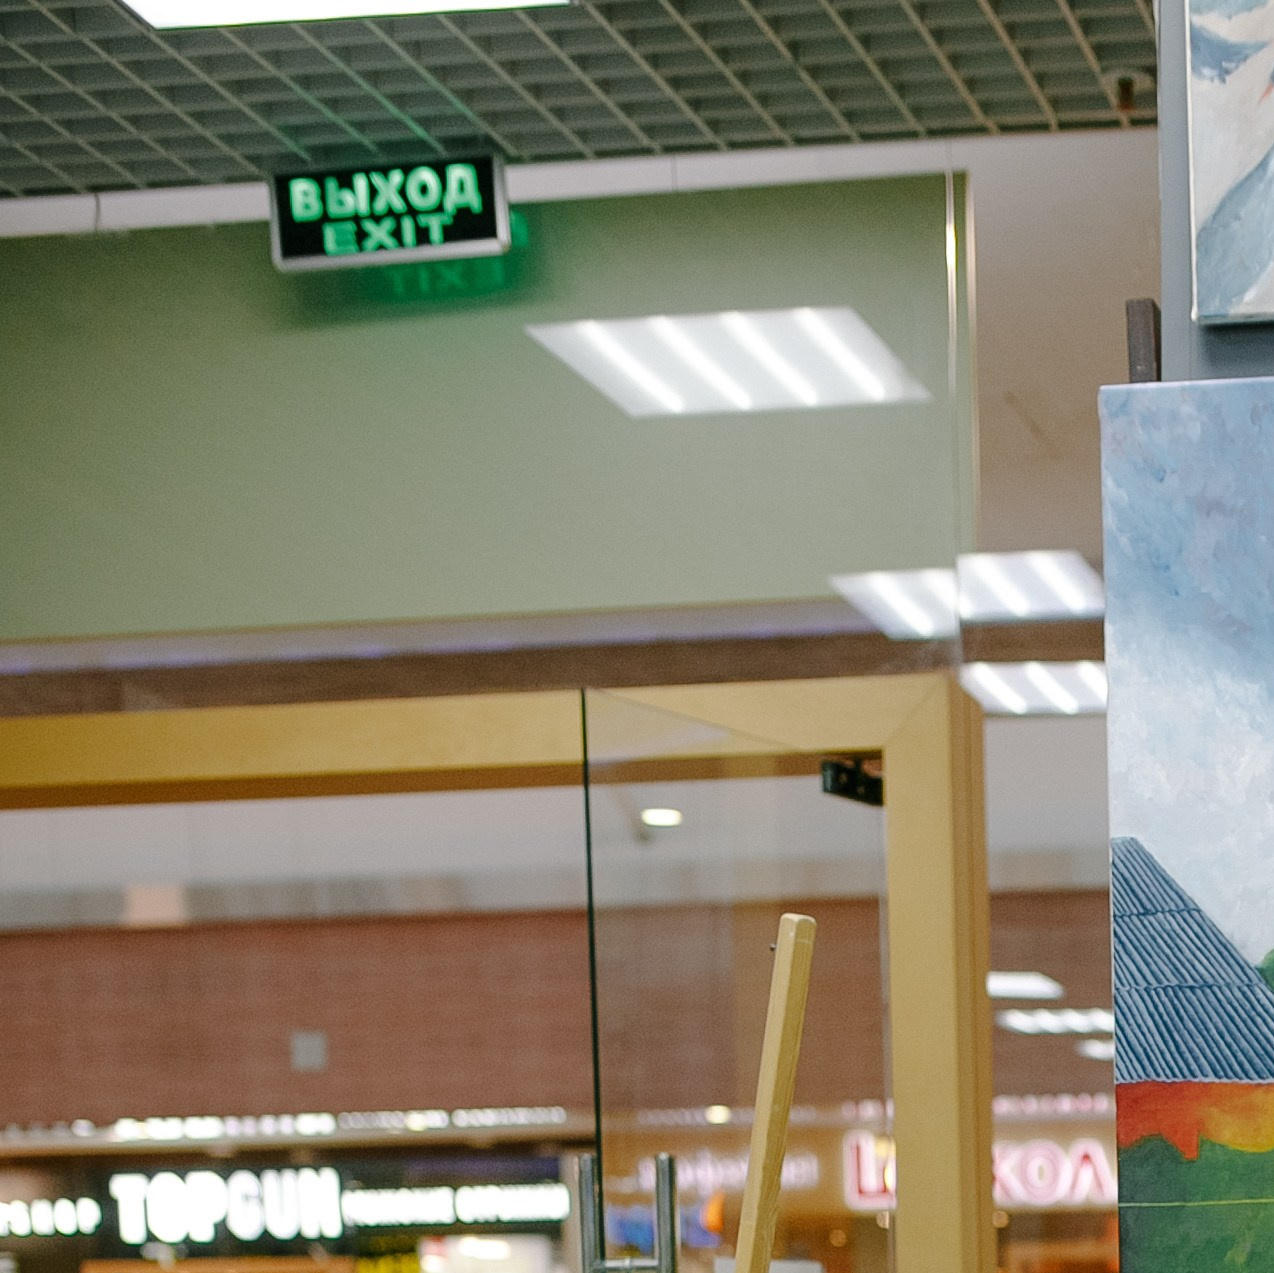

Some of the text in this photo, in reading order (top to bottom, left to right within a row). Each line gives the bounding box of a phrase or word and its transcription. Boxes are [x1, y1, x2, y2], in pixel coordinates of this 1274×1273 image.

[289, 163, 483, 223] ВЫХОД
[323, 212, 453, 256] EXIT
[109, 1167, 344, 1245] TOPGUN
